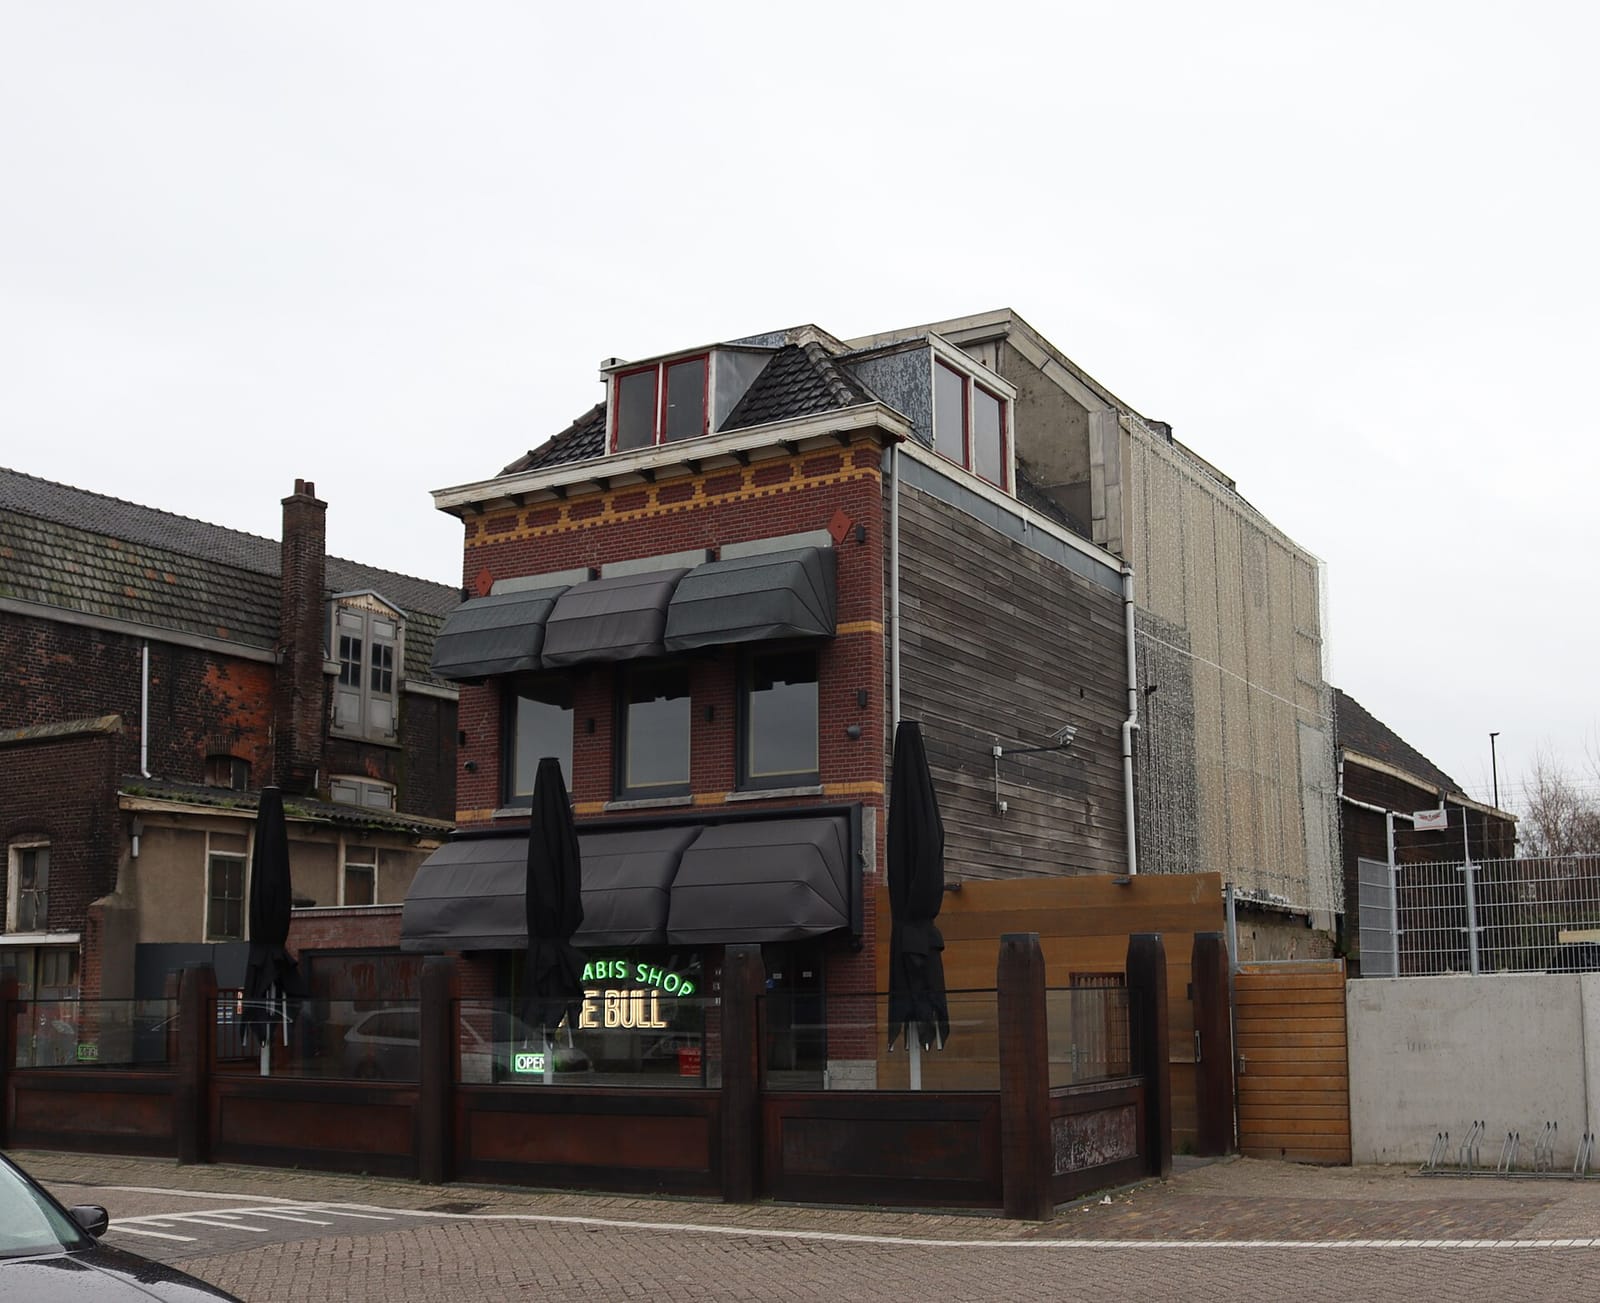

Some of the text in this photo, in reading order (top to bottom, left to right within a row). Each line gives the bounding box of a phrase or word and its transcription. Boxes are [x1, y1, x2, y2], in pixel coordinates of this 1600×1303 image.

[582, 960, 626, 980] ABIS
[636, 963, 694, 997] SHOP
[579, 989, 668, 1029] E BULL
